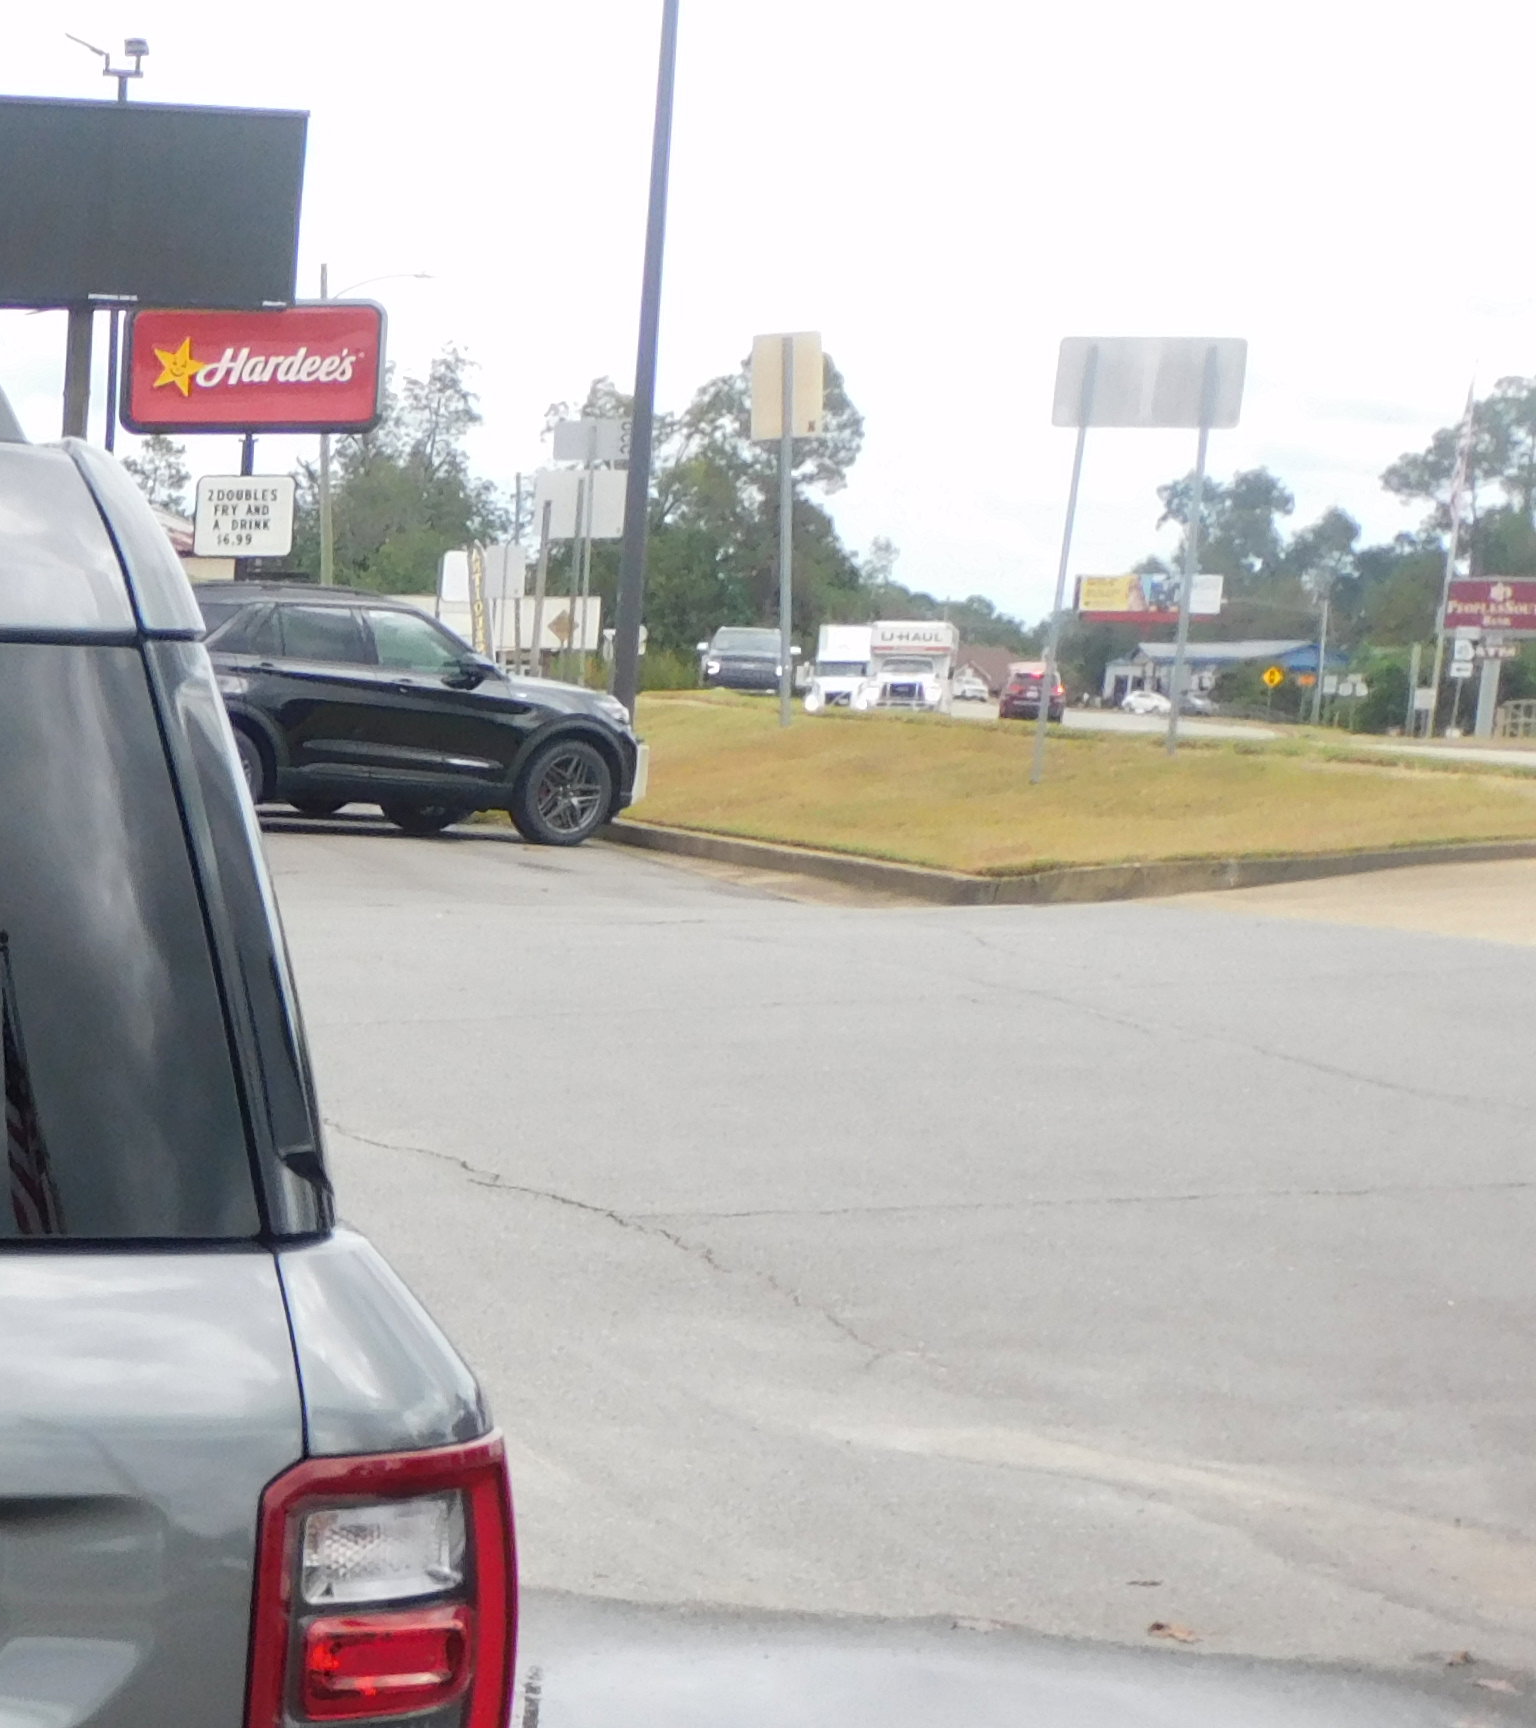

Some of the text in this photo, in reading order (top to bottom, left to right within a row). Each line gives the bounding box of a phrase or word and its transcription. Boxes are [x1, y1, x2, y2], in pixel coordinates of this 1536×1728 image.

[195, 346, 357, 388] Hardee's
[214, 504, 270, 516] FRY AND
[213, 519, 270, 531] A DRINK
[217, 533, 253, 546] $6.99
[881, 632, 943, 642] U-HAUL
